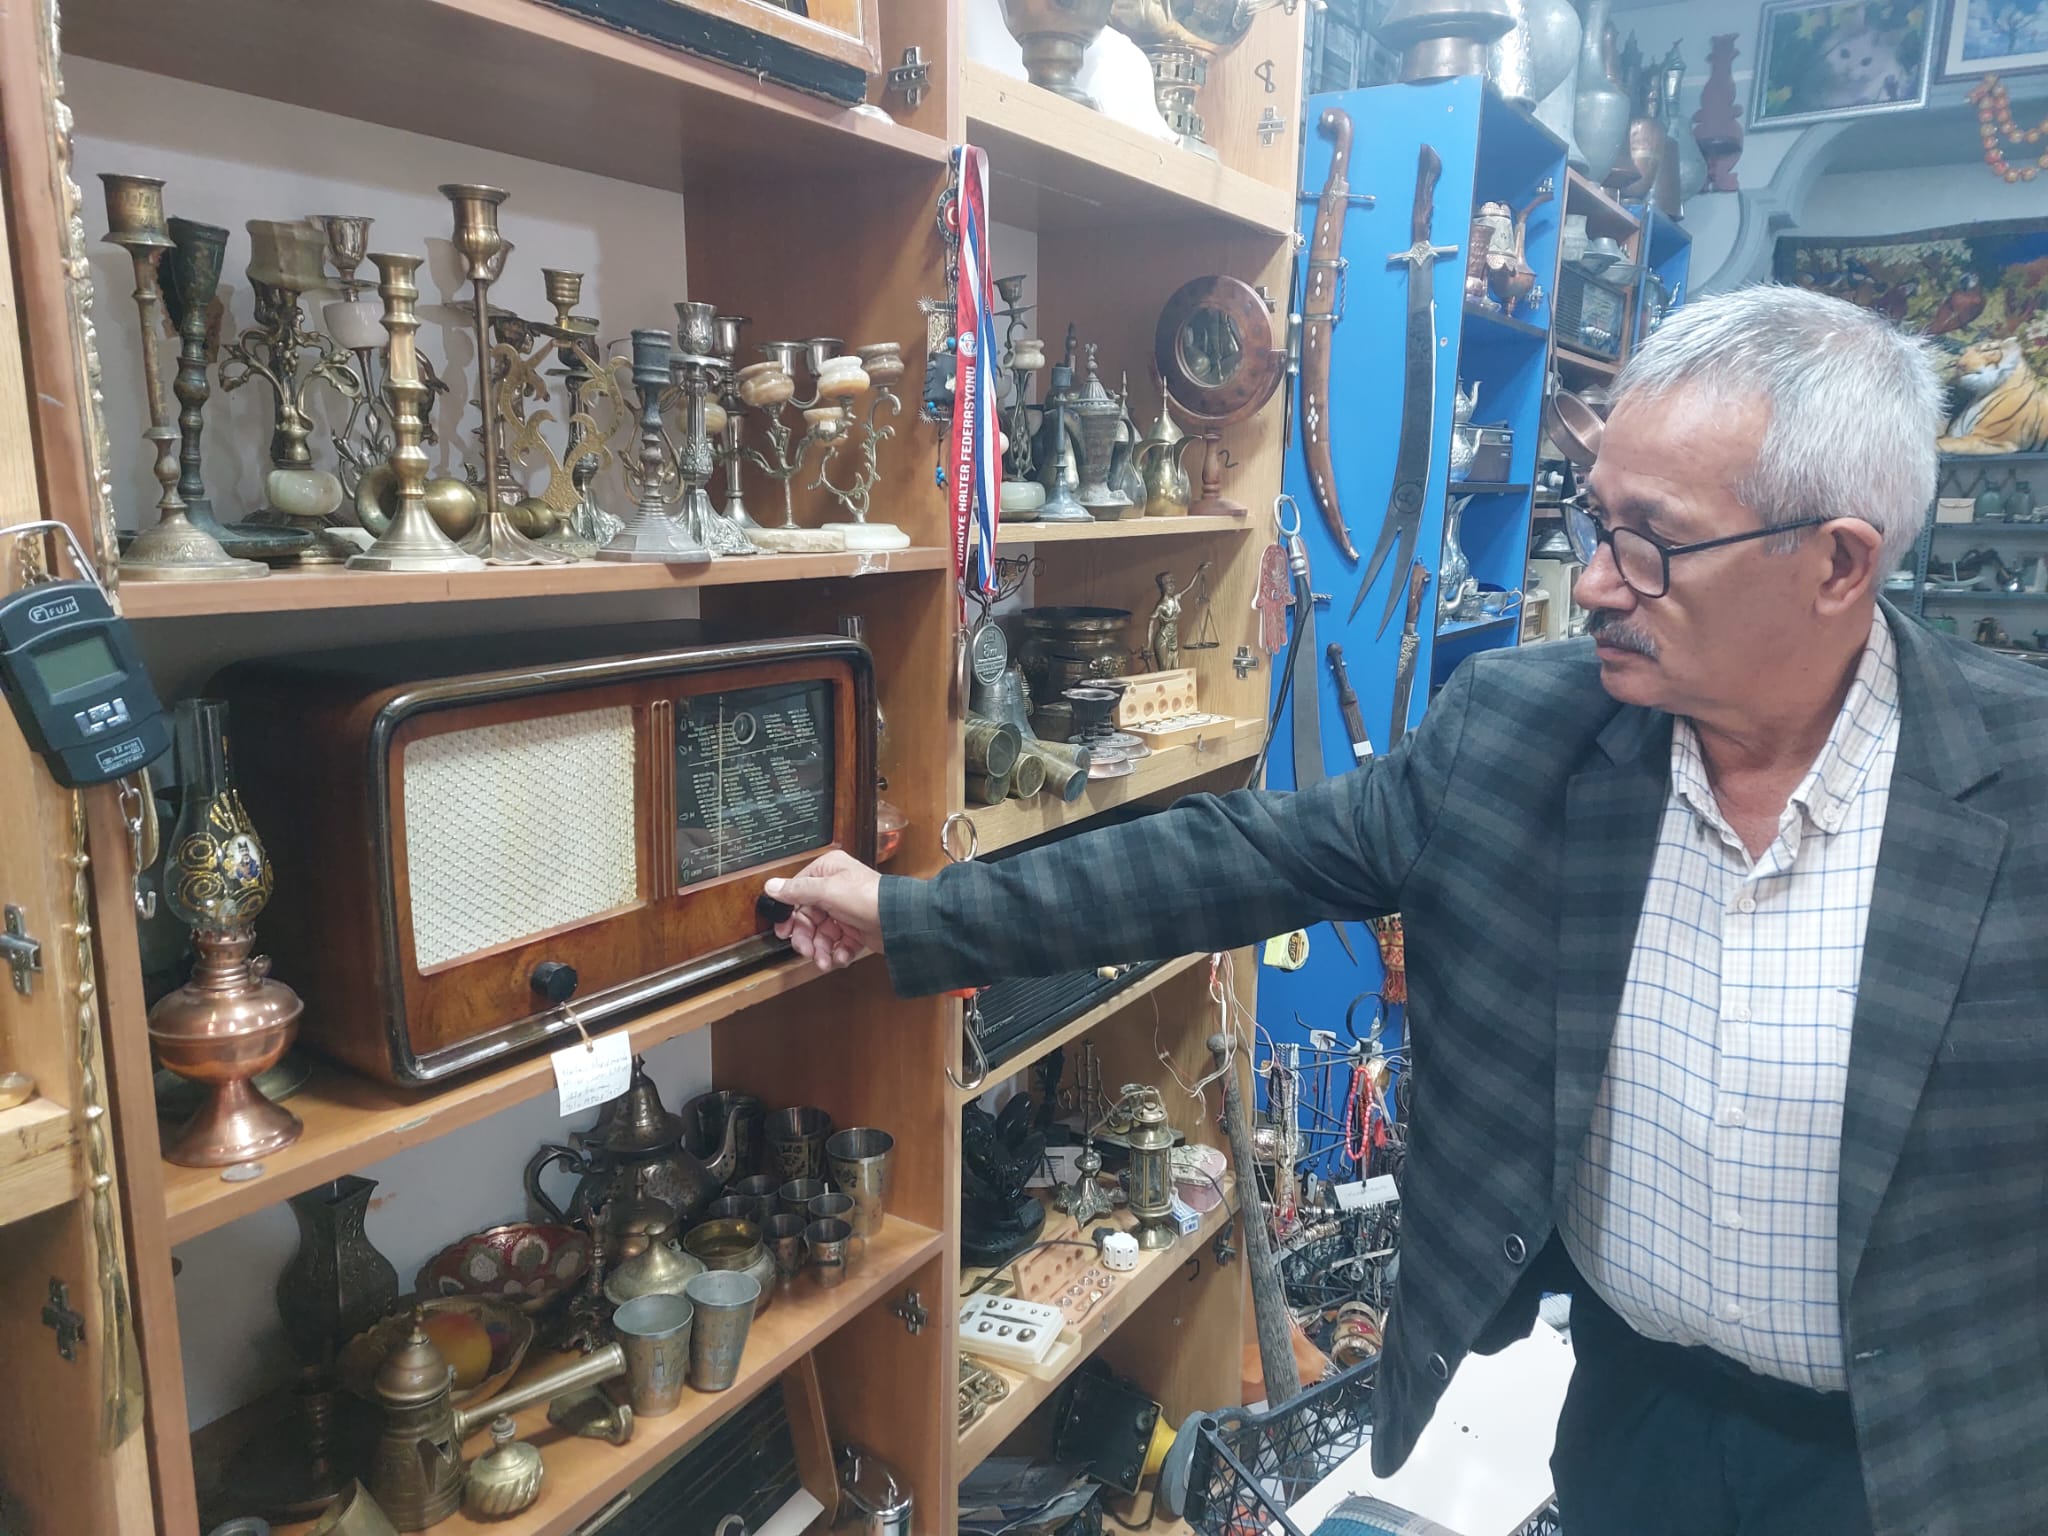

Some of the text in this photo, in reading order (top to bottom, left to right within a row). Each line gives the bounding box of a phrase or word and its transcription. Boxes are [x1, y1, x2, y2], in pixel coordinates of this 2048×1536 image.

[961, 366, 976, 461] FEDERASYONU
[1217, 449, 1239, 469] 2
[958, 464, 971, 511] HALTER
